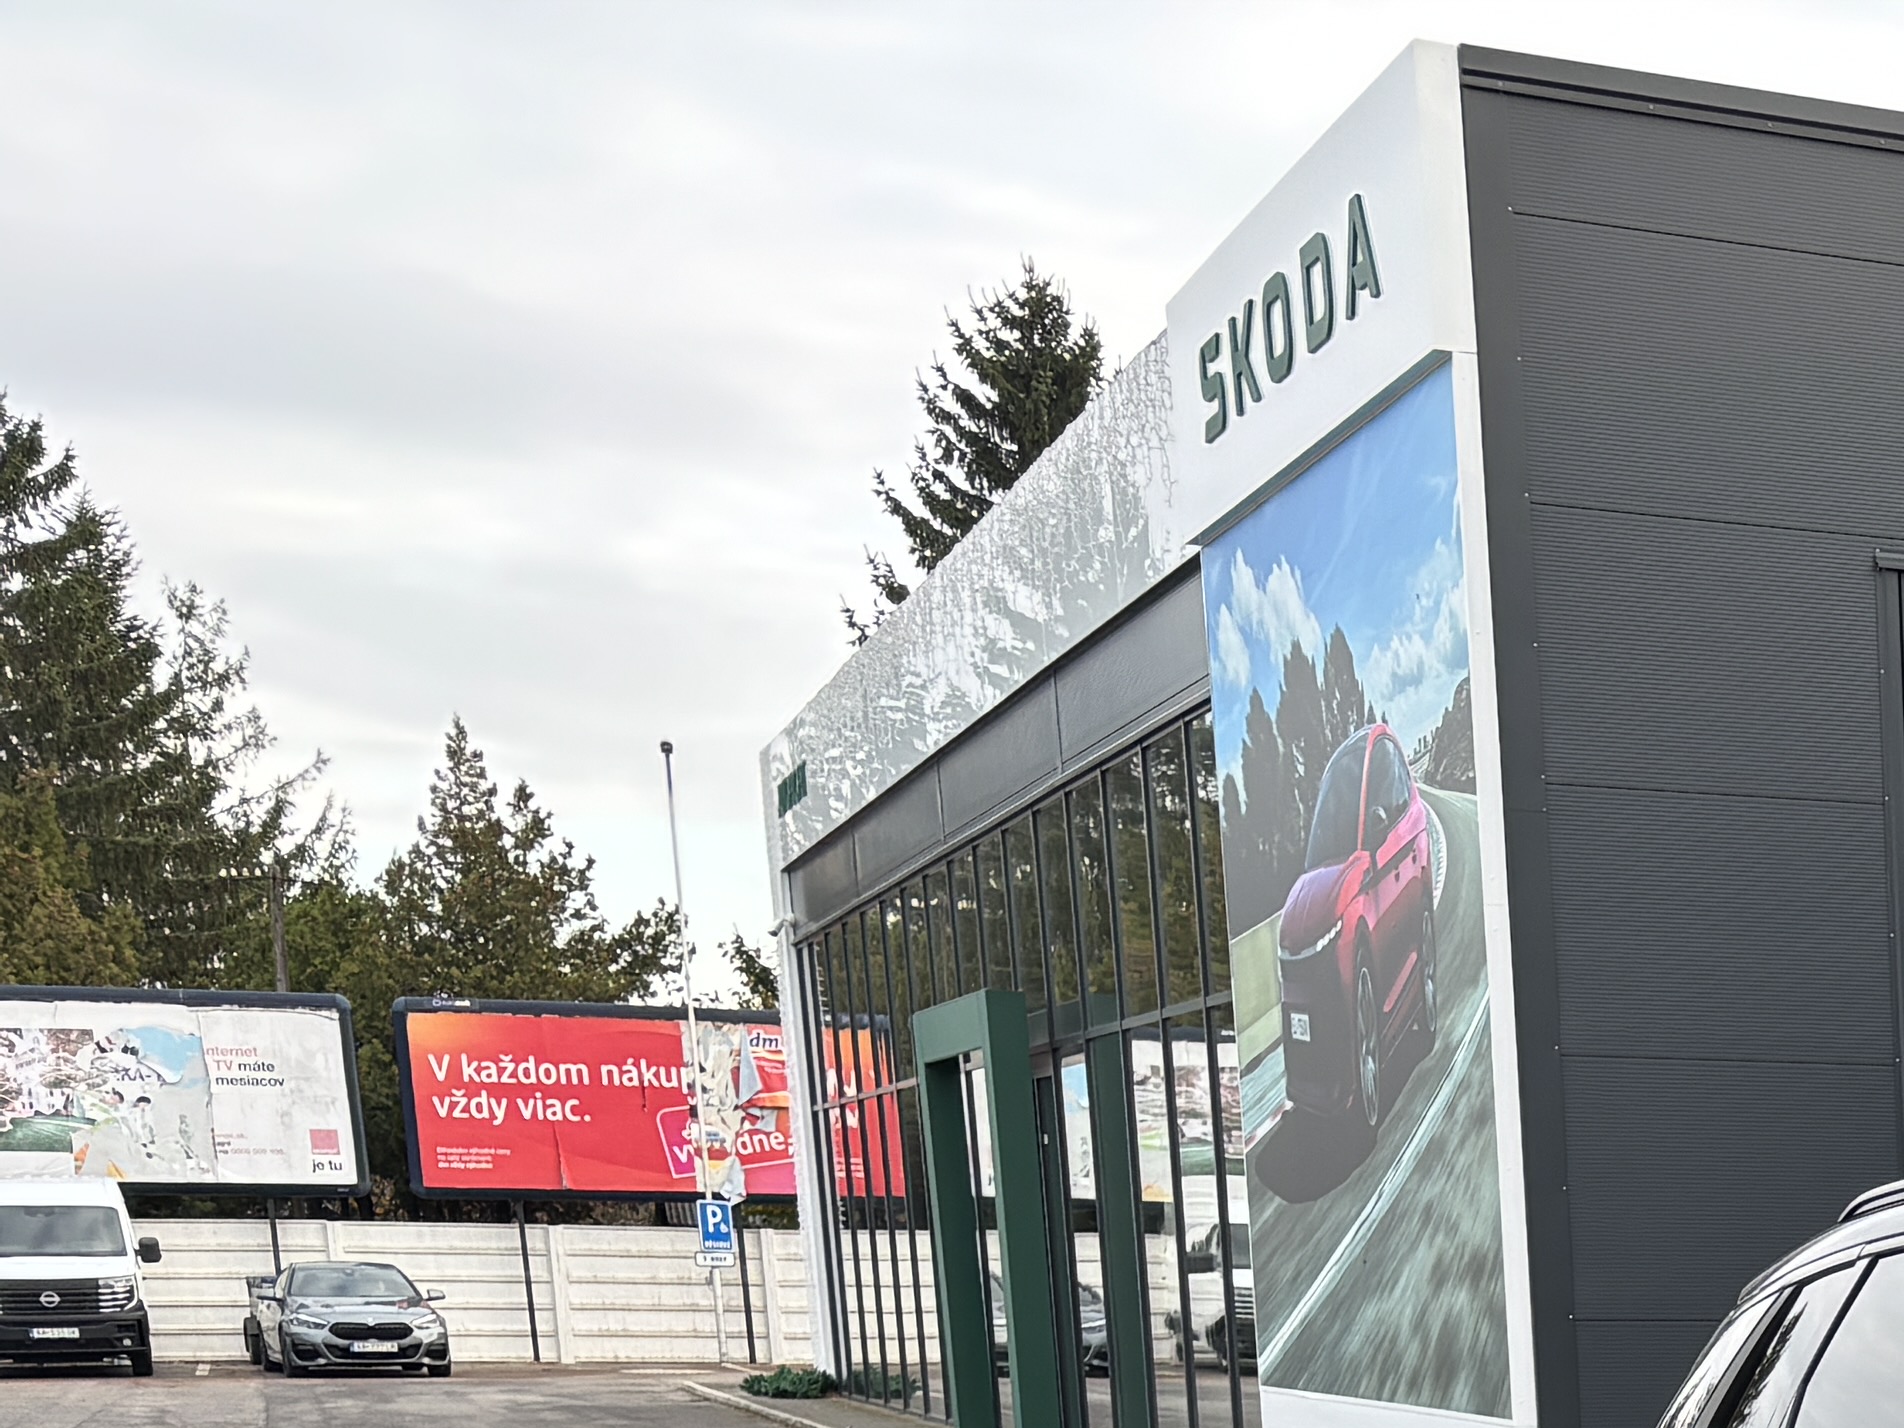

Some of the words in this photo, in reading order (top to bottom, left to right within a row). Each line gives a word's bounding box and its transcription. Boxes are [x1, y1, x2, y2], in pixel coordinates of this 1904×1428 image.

[749, 1032, 779, 1049] dm
[213, 1060, 233, 1072] TV
[427, 1053, 450, 1082] V
[461, 1053, 590, 1086] každom
[215, 1075, 285, 1087] mesiacov
[432, 1089, 508, 1126] vždy
[516, 1092, 592, 1122] viac.
[328, 1160, 343, 1171] tu
